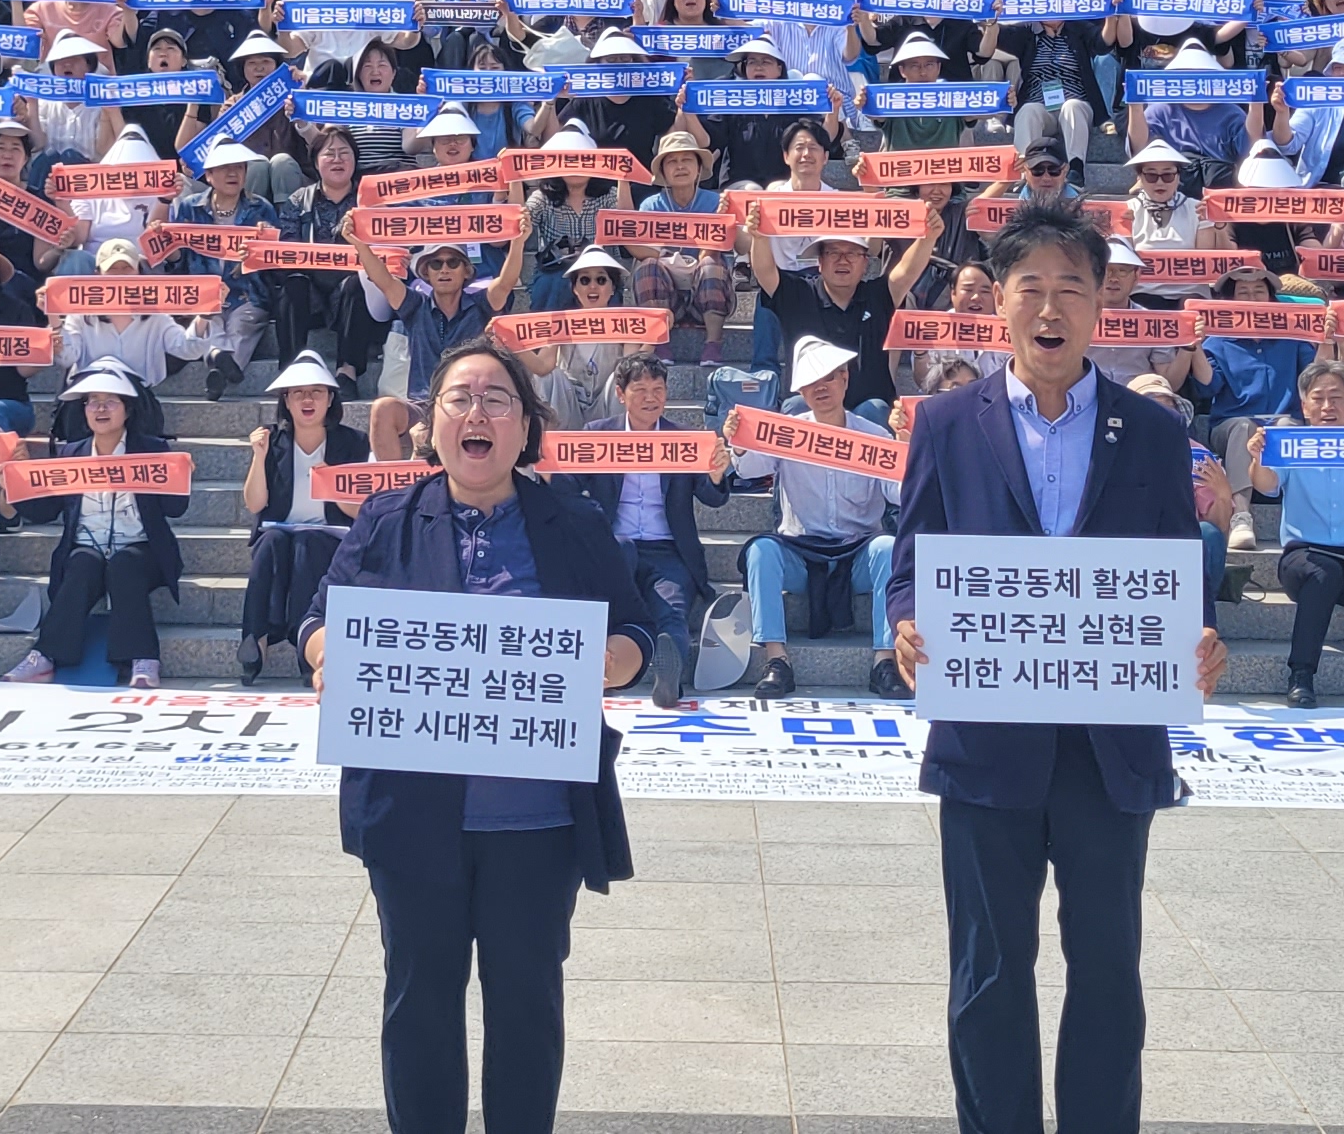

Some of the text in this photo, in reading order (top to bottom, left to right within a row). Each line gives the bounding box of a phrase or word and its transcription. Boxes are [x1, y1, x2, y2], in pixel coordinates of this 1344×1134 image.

[291, 7, 407, 25] 마을공동체활성화
[89, 78, 214, 99] 마을공동체활성화
[436, 77, 554, 96] 마을공동체활성화
[697, 89, 819, 107] 마을공동체활성화
[1136, 79, 1258, 97] 마을공동체활성화
[306, 98, 429, 121] 마을공동체활성화
[876, 91, 998, 109] 마을공동체활성화
[514, 154, 634, 174] 마을기본법 제정
[879, 155, 1001, 178] 마을기본법 제정
[56, 169, 176, 192] 마을기본법 제정
[377, 167, 498, 199] 마을기본법 제정
[1224, 196, 1344, 215] 마을기본법 제정
[33, 207, 63, 236] 제정
[371, 214, 503, 237] 마을기본법 제정
[779, 208, 910, 229] 마을기본법 제정
[604, 219, 727, 242] 마을기본법 제정
[69, 284, 199, 306] 마을기본법 제정
[516, 316, 646, 342] 마을기본법 제정
[904, 323, 993, 342] 마을기본법
[1144, 318, 1179, 339] 제정
[557, 442, 699, 463] 마을기본법 제정
[756, 420, 898, 470] 마을기본법 제정
[30, 464, 168, 487] 마을기본법 제정
[936, 566, 1180, 600] 마을공동체 활성화
[346, 617, 584, 660] 마을공동체 활성화
[950, 613, 1165, 646] 주민주권 실현을
[357, 663, 567, 704] 주민주권 실현을
[944, 658, 1179, 691] 위한 시대적 과제!
[348, 708, 578, 749] 위한 시대적 과제!
[196, 742, 300, 753] 18일
